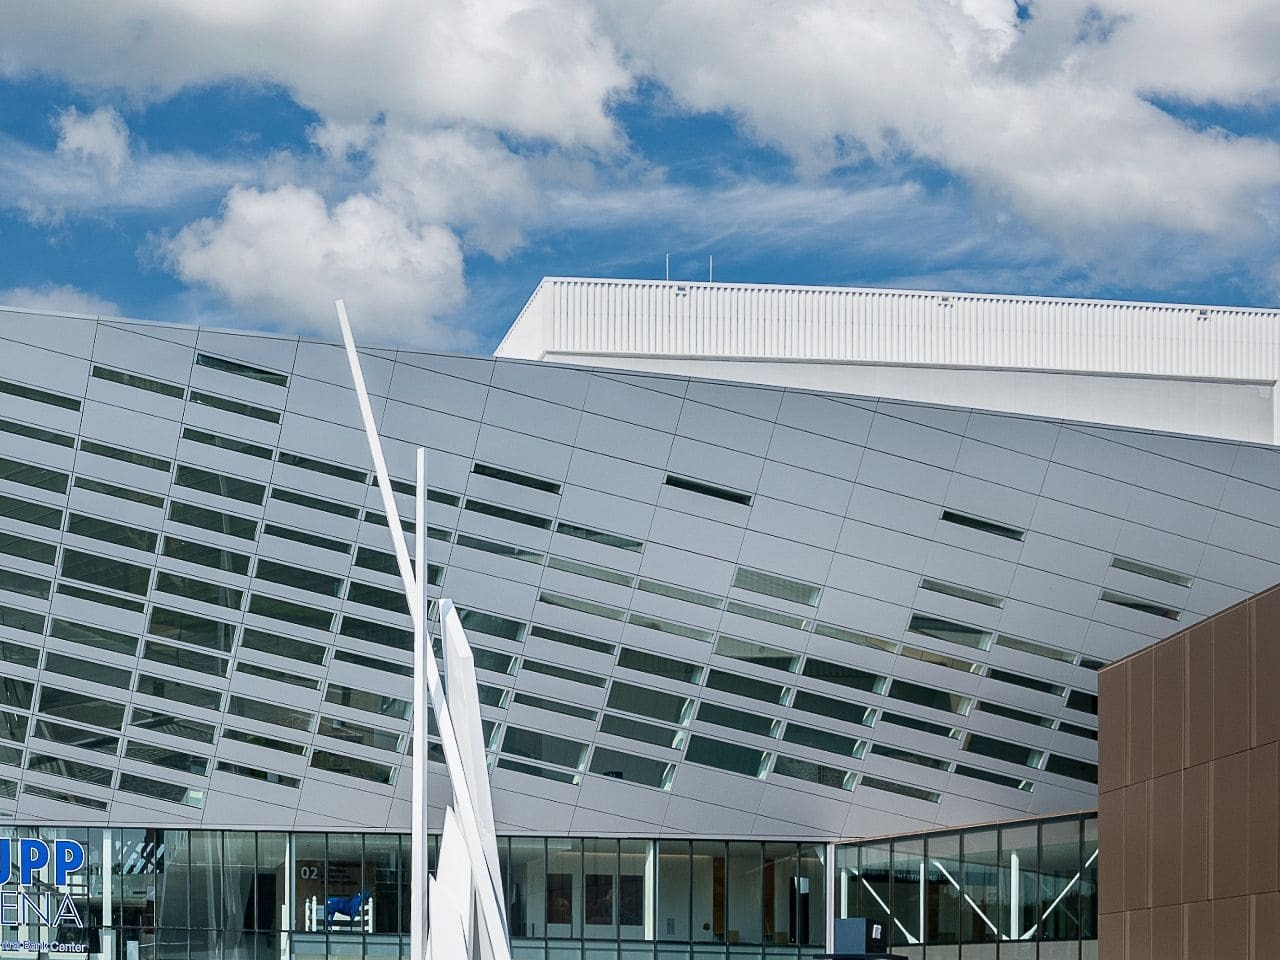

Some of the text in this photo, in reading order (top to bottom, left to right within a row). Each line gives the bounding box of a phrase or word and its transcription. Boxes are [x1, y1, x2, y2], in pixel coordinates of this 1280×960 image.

[301, 867, 318, 879] 02
[23, 940, 49, 951] Bank
[50, 942, 86, 952] Center
